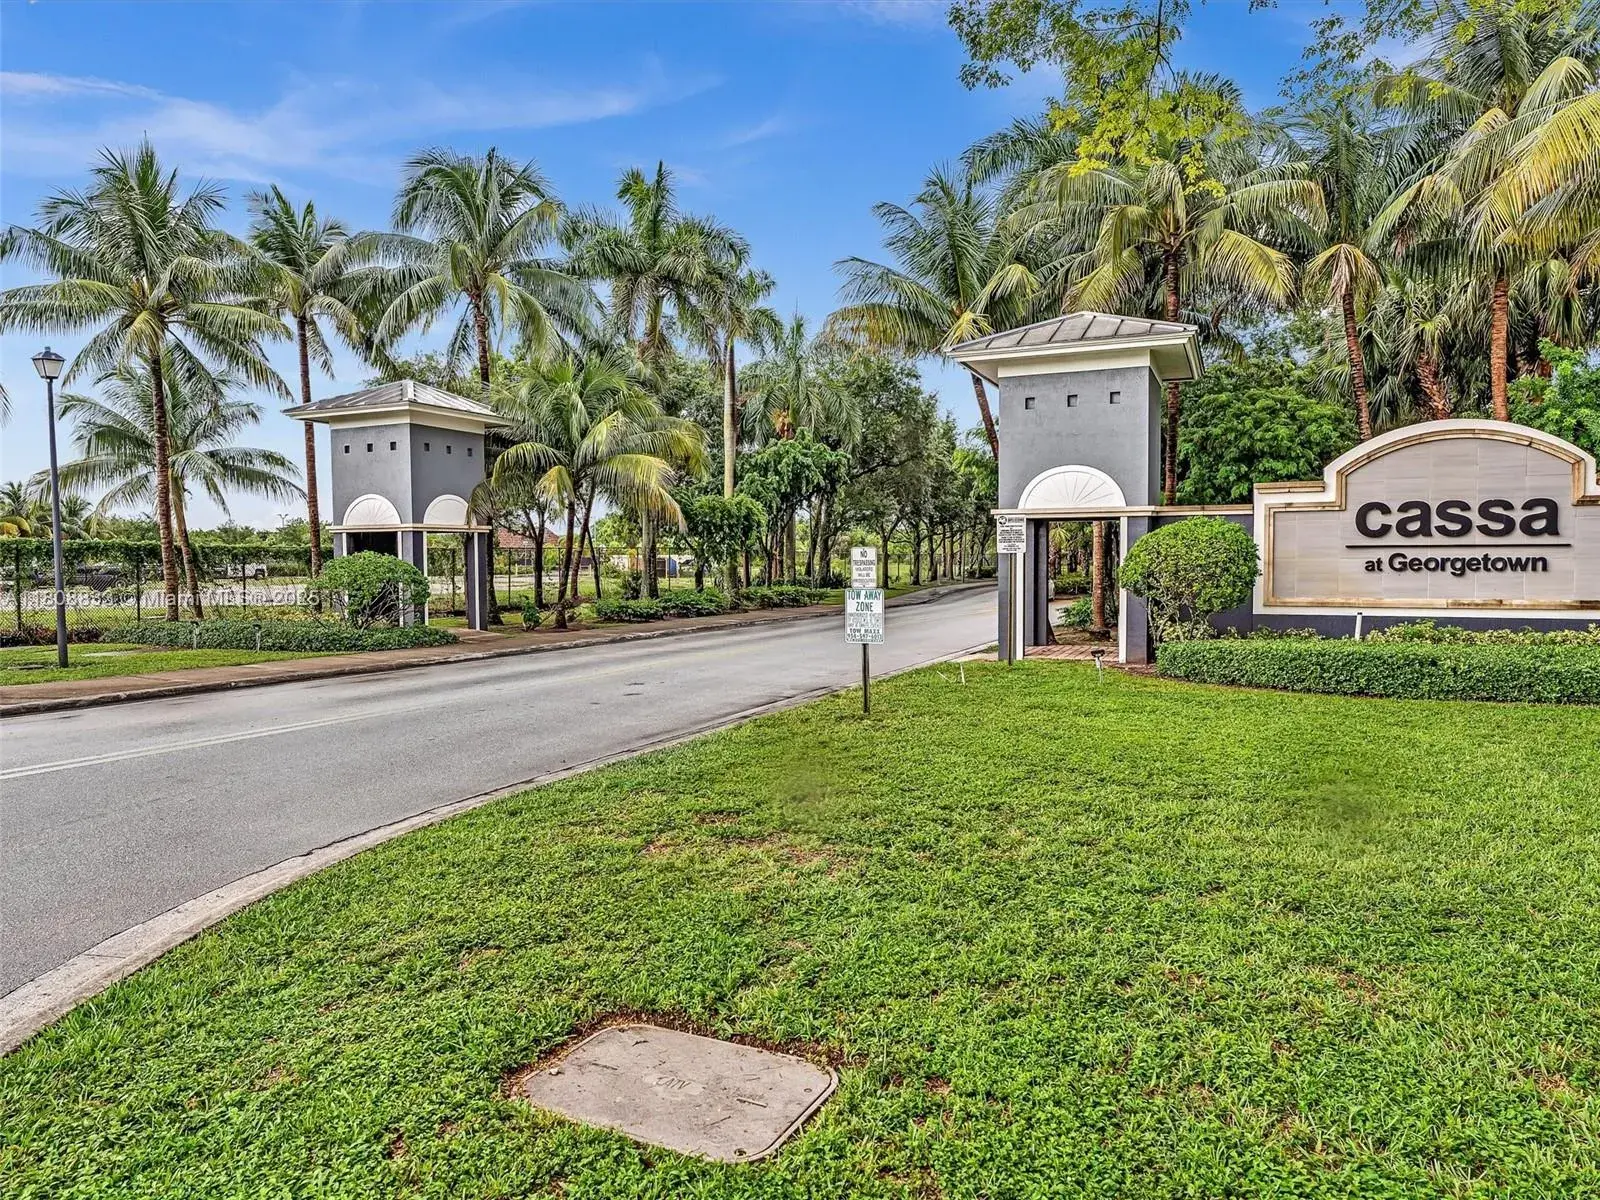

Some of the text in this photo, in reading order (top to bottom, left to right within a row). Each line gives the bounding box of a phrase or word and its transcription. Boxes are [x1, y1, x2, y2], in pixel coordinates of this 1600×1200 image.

[1355, 497, 1560, 539] cassa
[860, 550, 868, 558] NO
[1364, 552, 1548, 577] at Georgetown
[848, 590, 881, 601] TOW AWAY
[855, 601, 873, 612] ZONE
